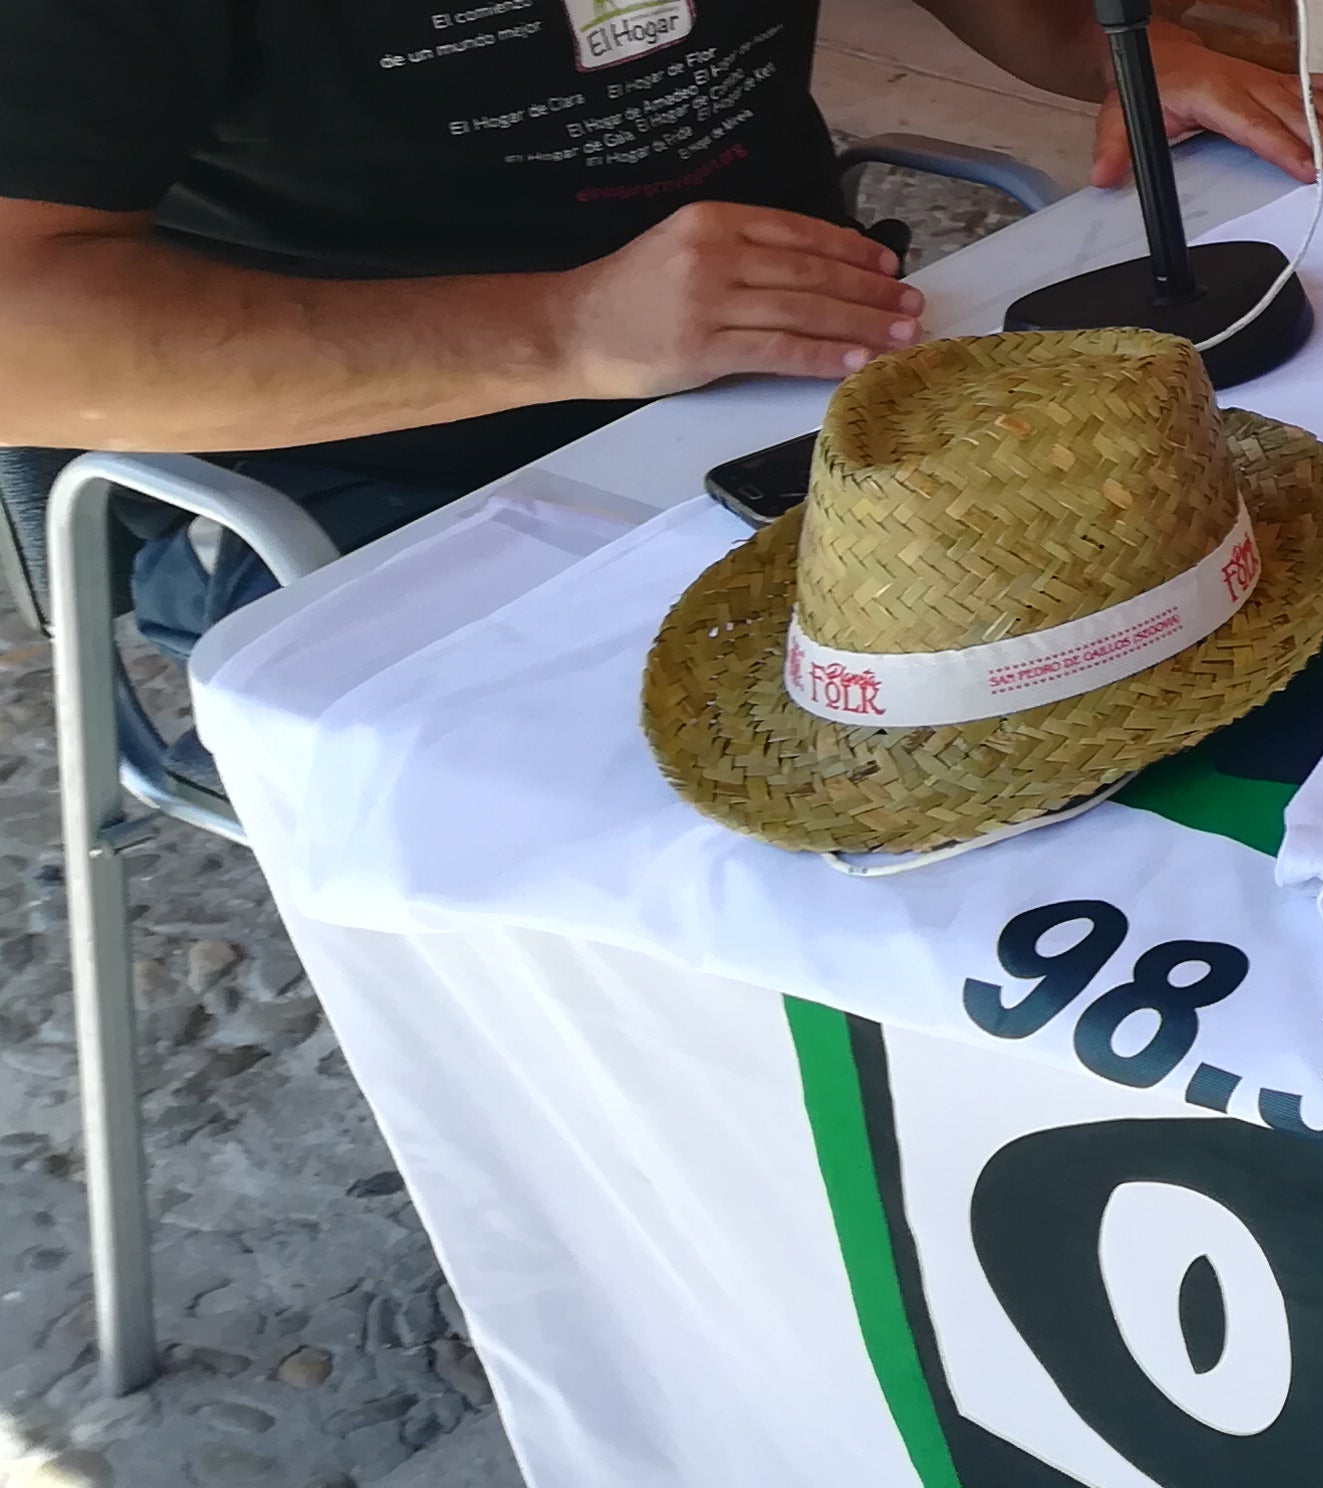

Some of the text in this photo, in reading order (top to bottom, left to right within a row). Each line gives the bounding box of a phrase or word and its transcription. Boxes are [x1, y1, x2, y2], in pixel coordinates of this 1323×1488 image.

[379, 53, 407, 69] de
[408, 48, 435, 63] un
[436, 33, 497, 57] mundo
[586, 14, 681, 58] El Hogar
[449, 120, 471, 135] El
[472, 110, 525, 130] Hogar
[809, 661, 887, 716] FOLK
